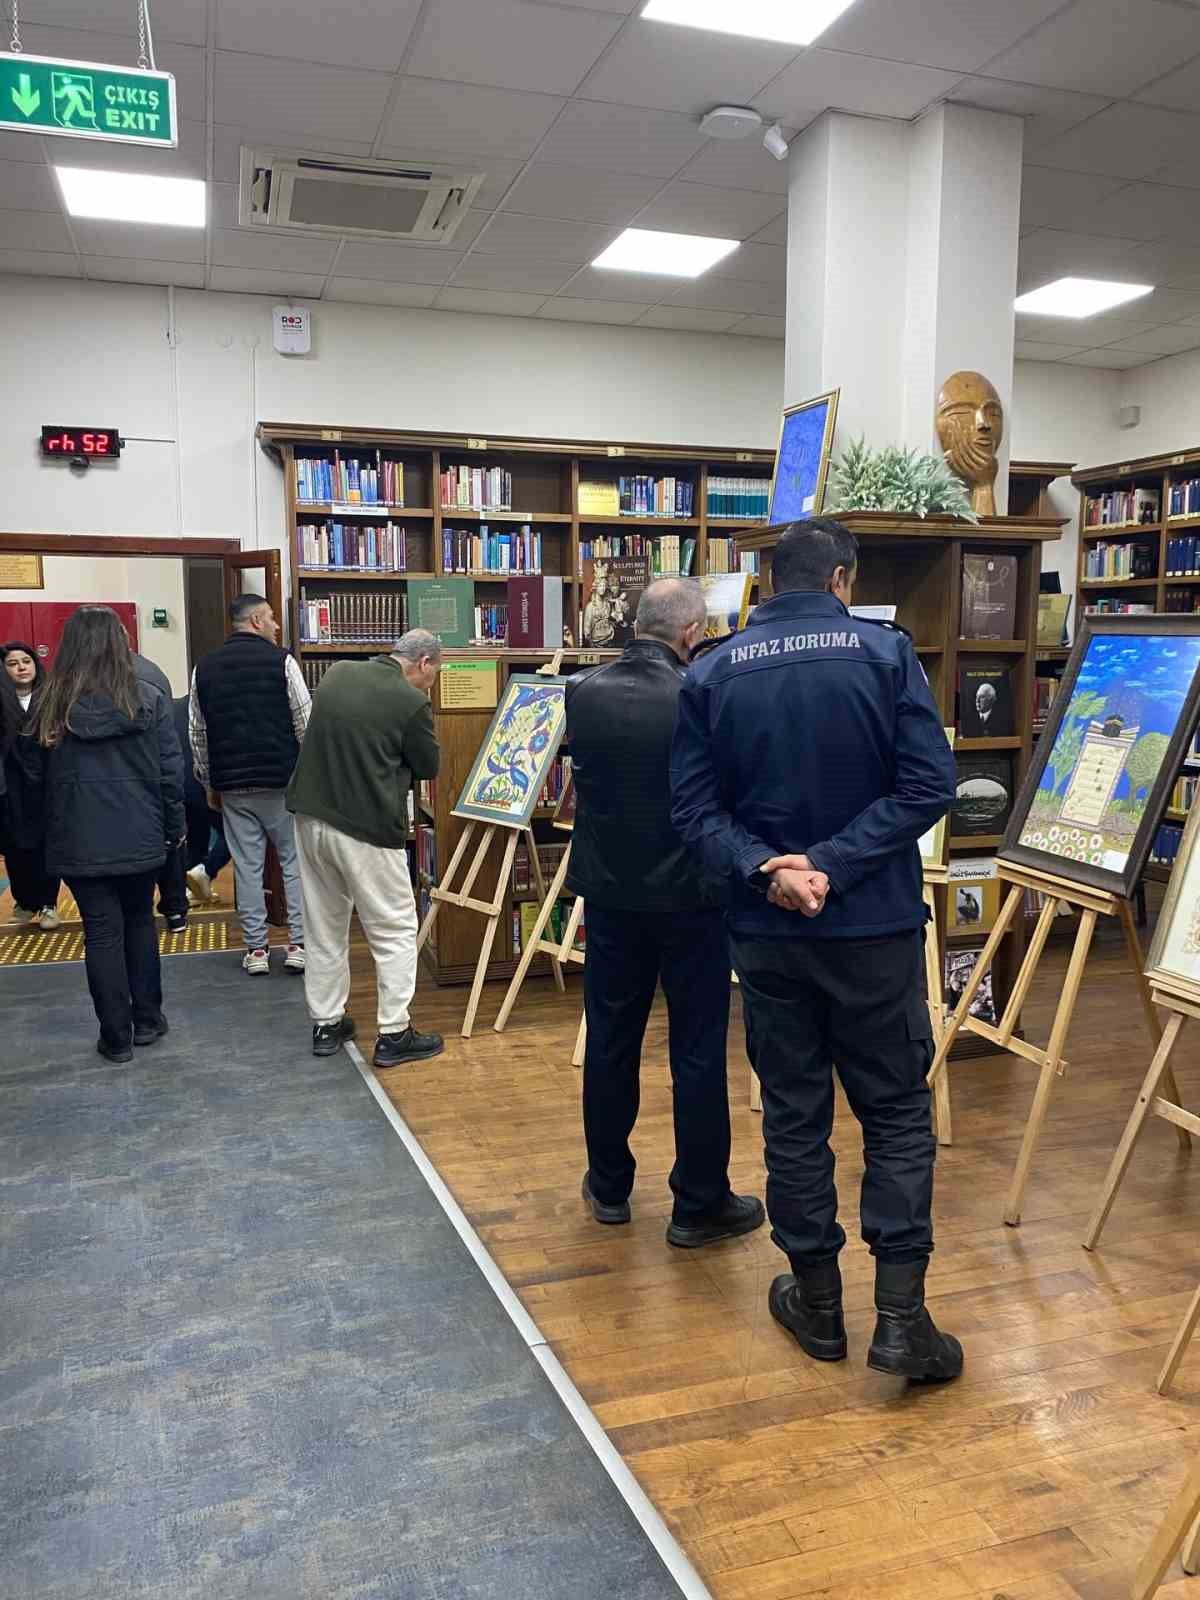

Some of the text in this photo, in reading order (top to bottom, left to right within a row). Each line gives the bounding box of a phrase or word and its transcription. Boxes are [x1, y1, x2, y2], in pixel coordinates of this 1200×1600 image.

[104, 84, 160, 110] ÇIKIŞ
[105, 108, 160, 132] EXIT
[48, 433, 109, 453] rh 52
[783, 631, 861, 653] KORUMA
